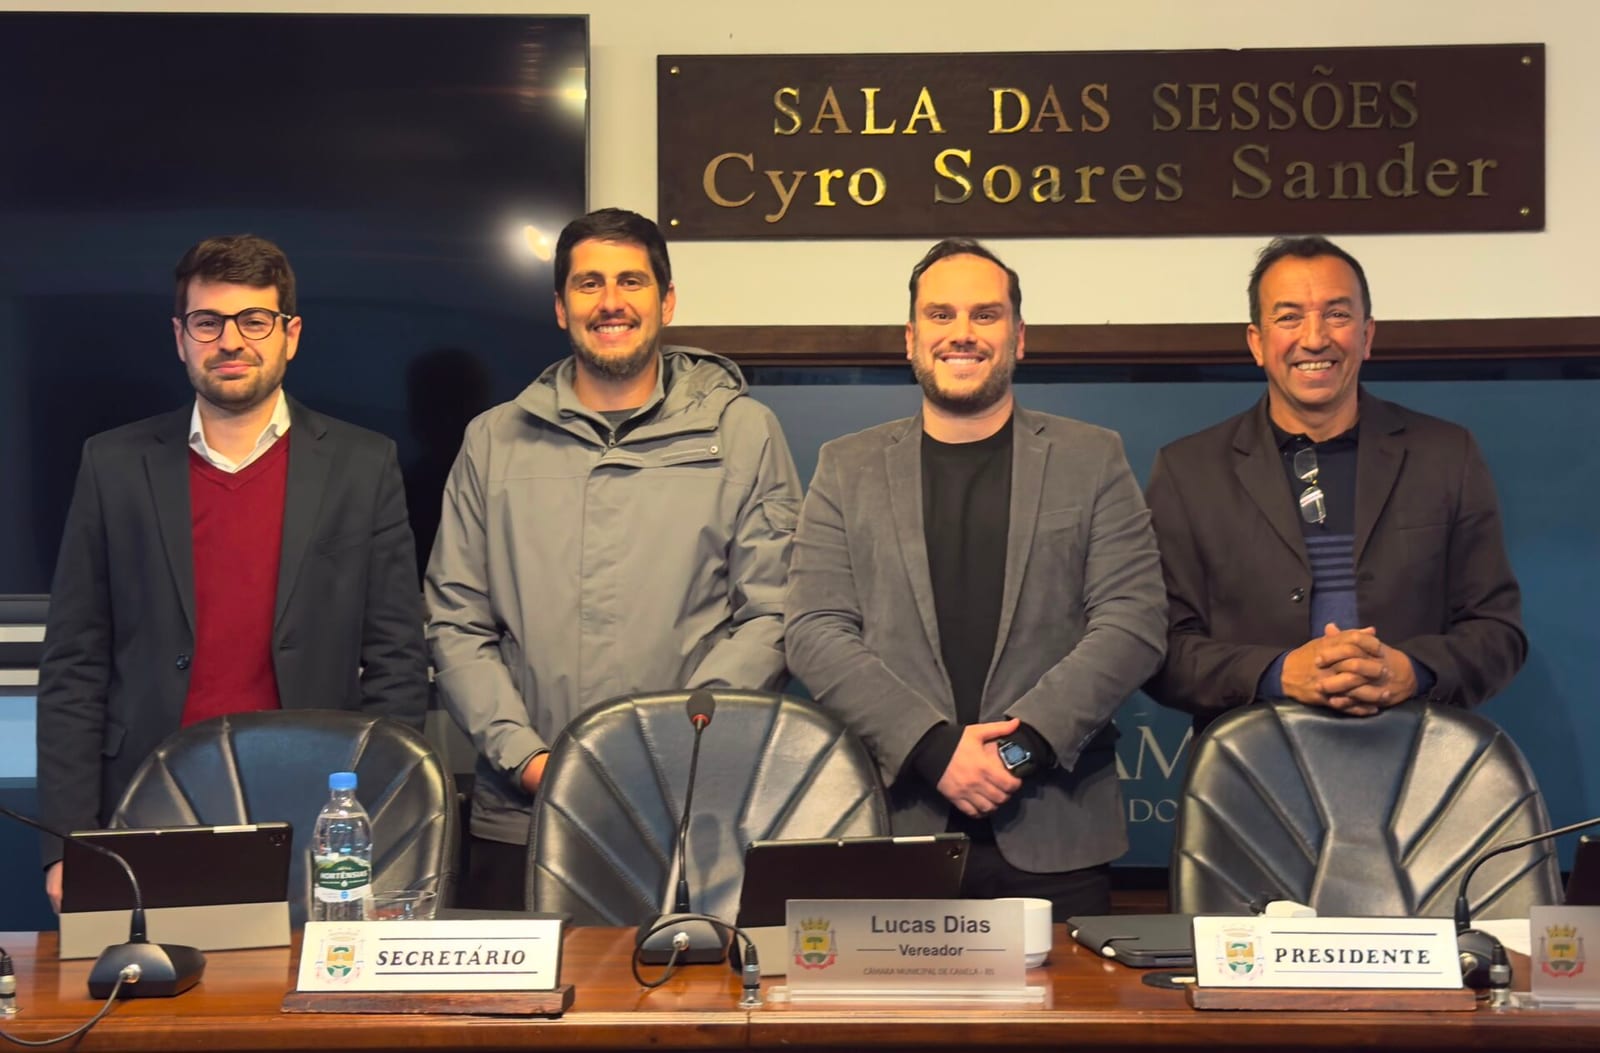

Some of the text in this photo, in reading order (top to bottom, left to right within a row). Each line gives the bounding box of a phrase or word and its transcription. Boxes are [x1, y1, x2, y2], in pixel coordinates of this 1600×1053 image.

[773, 64, 1419, 136] SALA DAS SESSÕES
[702, 141, 1498, 223] Cyro Soares Sander
[871, 915, 992, 934] Lucas Dias
[375, 944, 527, 967] SECRETÁRIO
[898, 944, 964, 957] Vereador
[1274, 947, 1431, 965] PRESIDENTE
[896, 966, 937, 976] MUNICIPAL
[937, 967, 949, 976] DE
